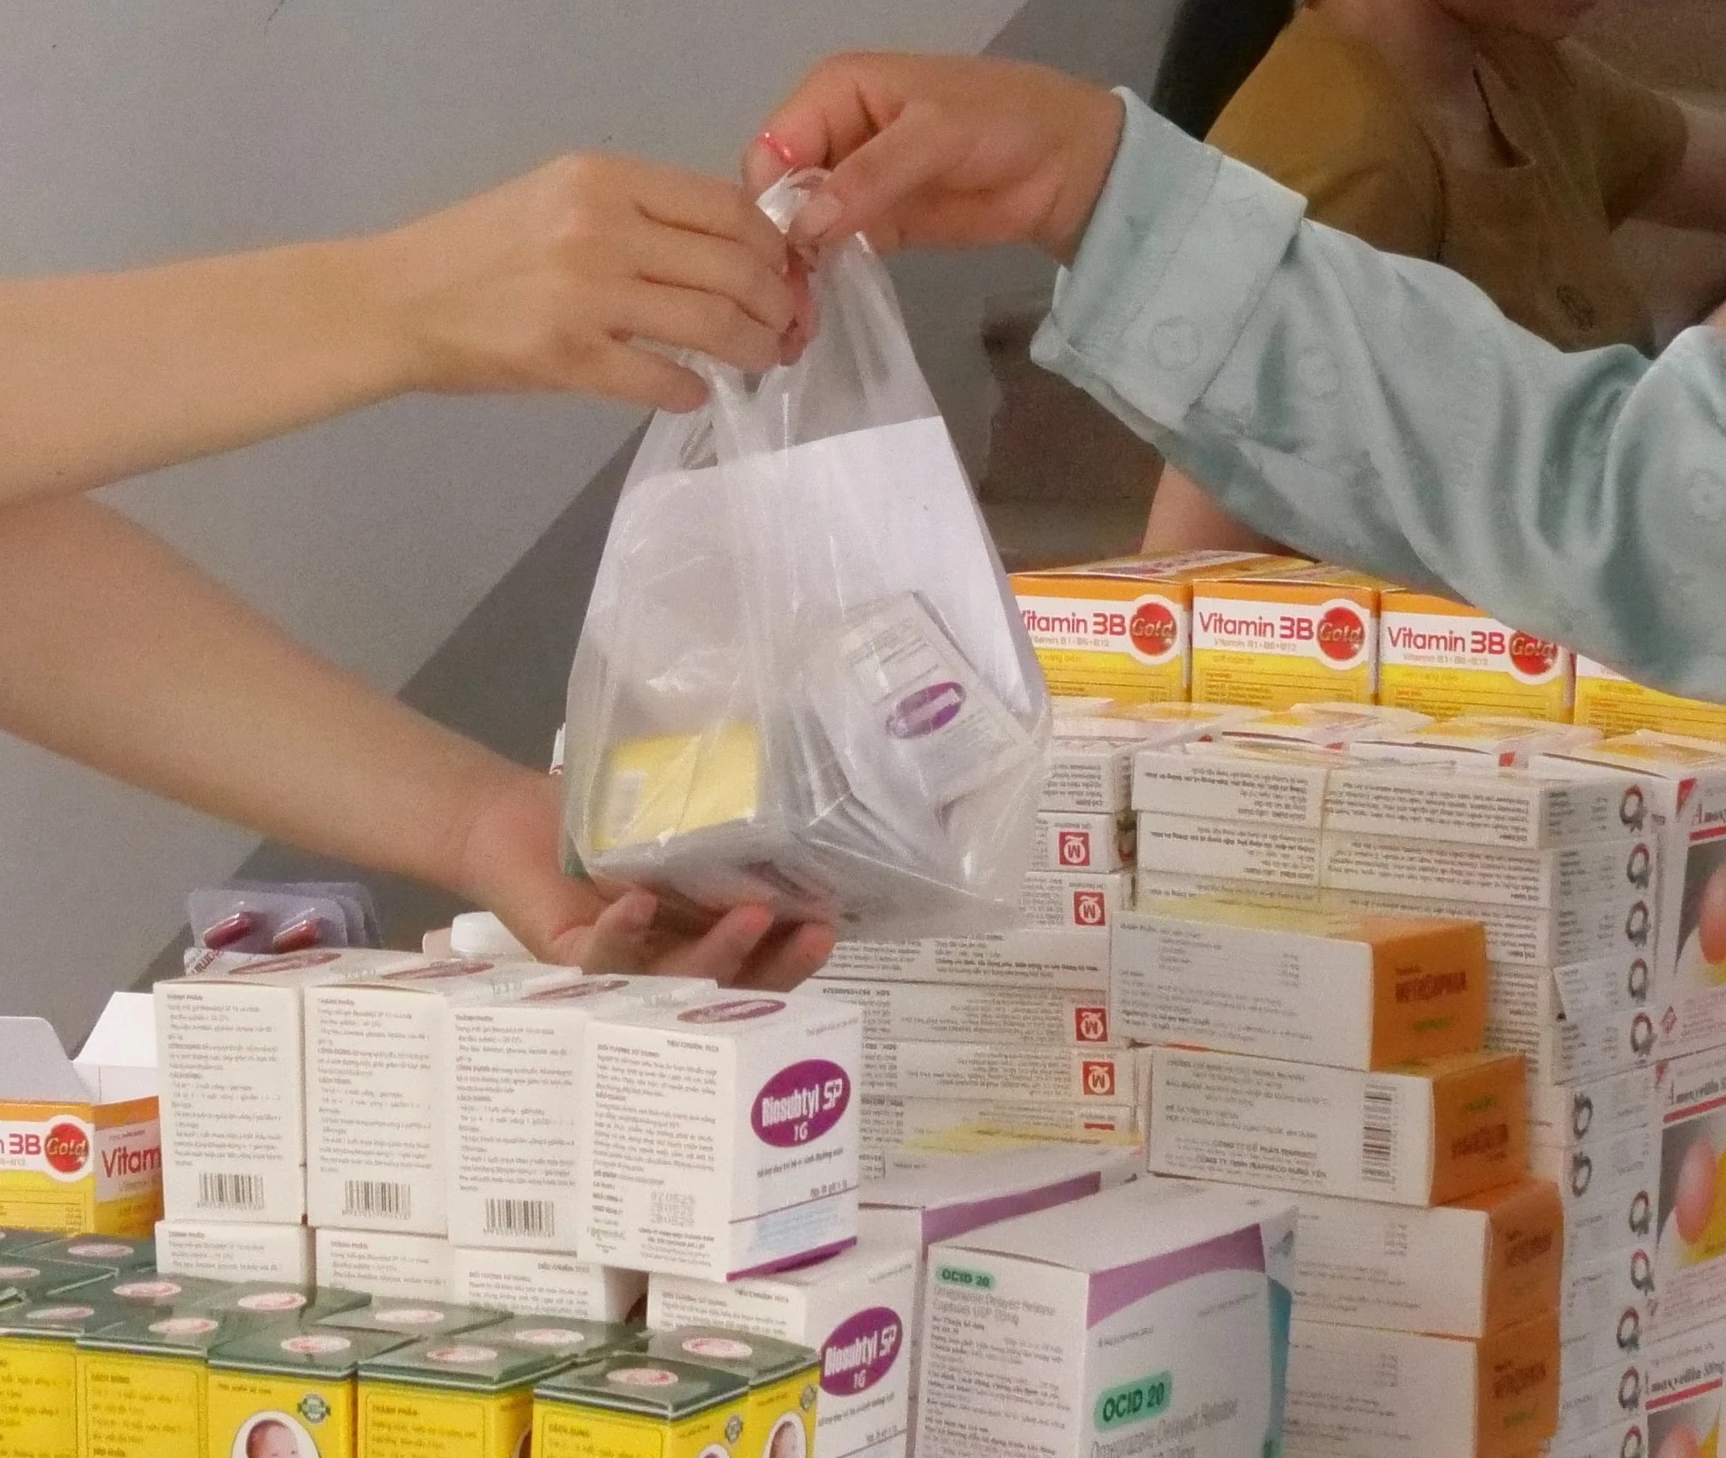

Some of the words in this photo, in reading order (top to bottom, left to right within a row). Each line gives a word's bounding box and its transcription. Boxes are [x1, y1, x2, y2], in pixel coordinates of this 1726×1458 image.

[1092, 613, 1126, 636] 3B
[1130, 618, 1177, 639] Gold
[1199, 612, 1274, 638] Vitamin
[1279, 616, 1314, 641] 3B
[1317, 622, 1366, 645] Gold
[1388, 626, 1466, 653] Vitamin
[1470, 630, 1505, 656] 3B
[762, 1083, 820, 1127] Biosubtyl
[823, 1078, 843, 1111] SP
[9, 1133, 41, 1155] 3B
[44, 1136, 89, 1156] Gold
[102, 1144, 162, 1179] Vitam
[942, 1268, 972, 1283] OCID
[975, 1275, 990, 1288] 20
[1102, 1388, 1143, 1423] OCID
[1146, 1382, 1165, 1409] 20
